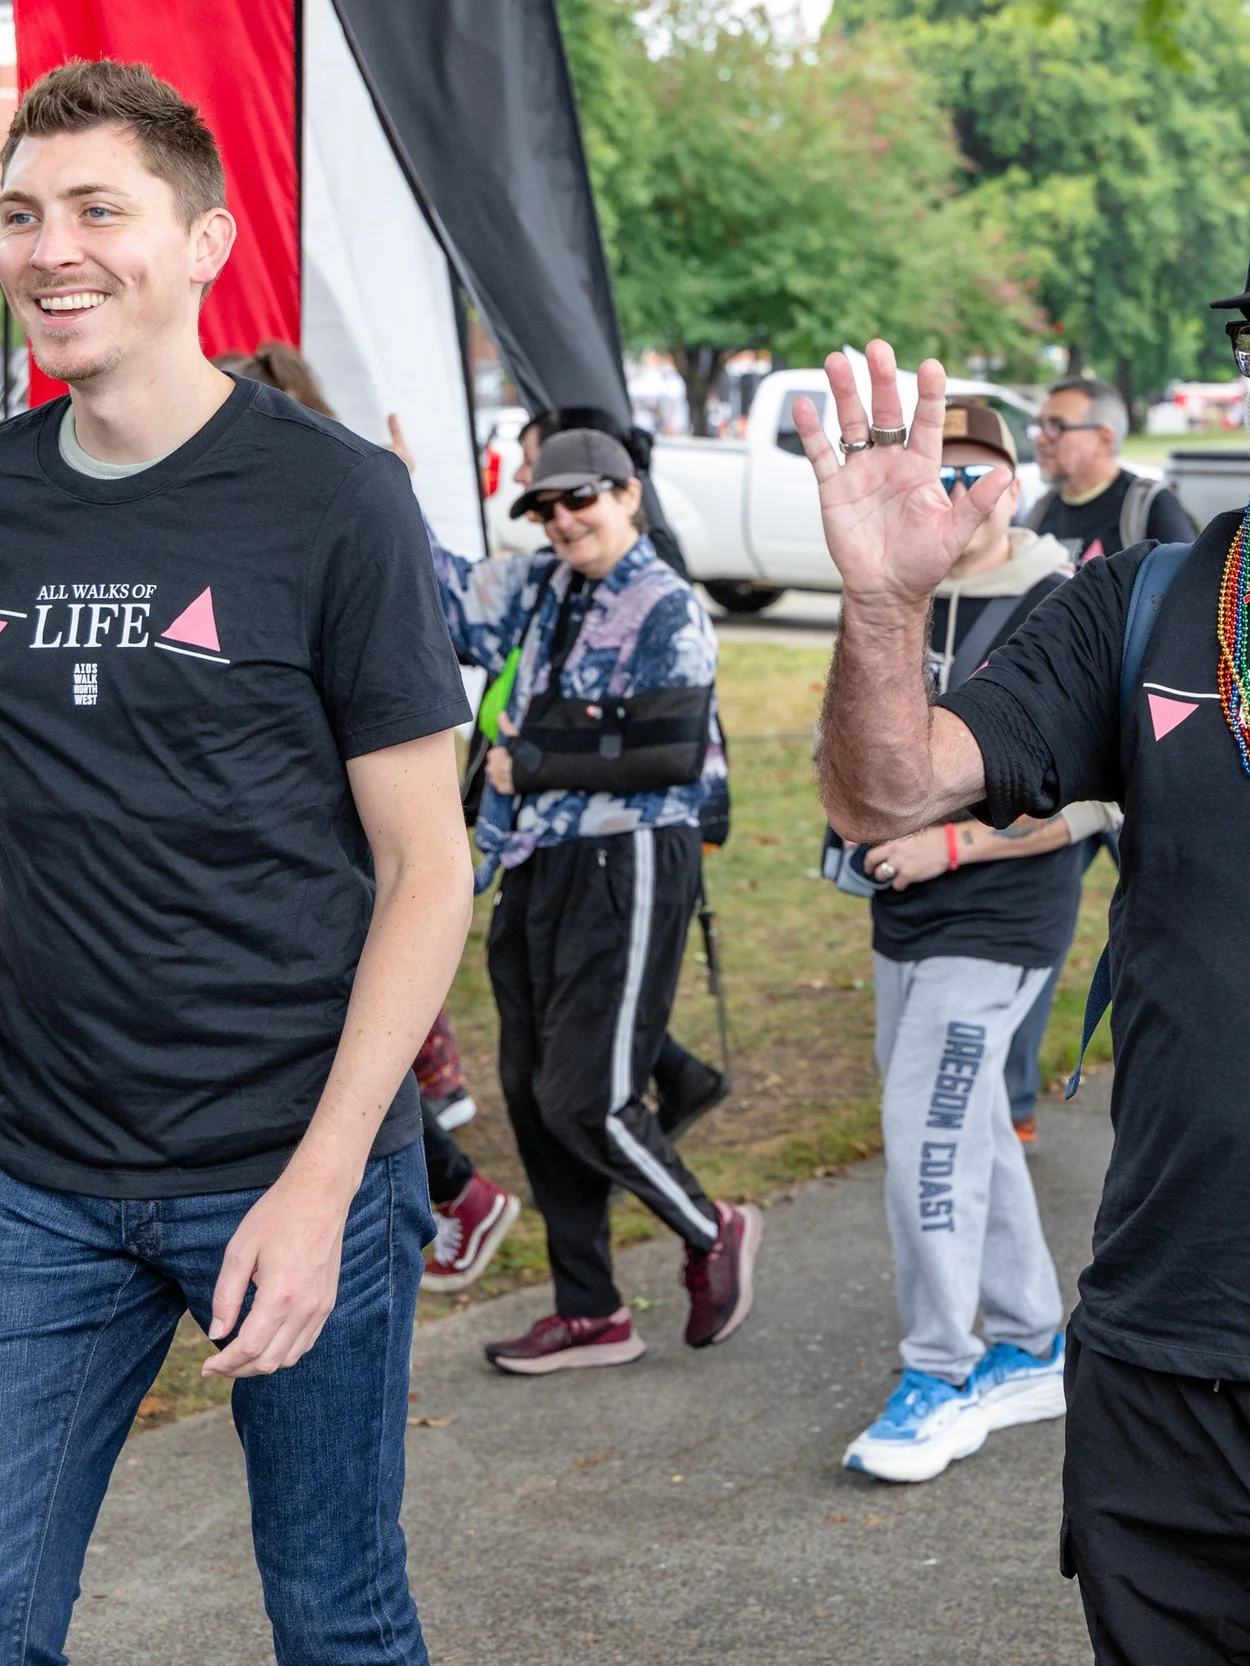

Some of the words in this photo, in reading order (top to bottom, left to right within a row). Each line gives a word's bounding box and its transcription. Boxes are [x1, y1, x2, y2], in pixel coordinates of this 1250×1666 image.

[36, 584, 69, 600] ALL
[72, 583, 130, 599] WALKS
[131, 583, 157, 599] OF
[29, 603, 151, 649] LIFE
[73, 663, 98, 674] AIDS
[73, 674, 98, 684] WALK
[73, 684, 98, 694] NORTH
[73, 694, 98, 705] WEST
[925, 1020, 986, 1130] OREGON
[918, 1141, 957, 1233] COAST
